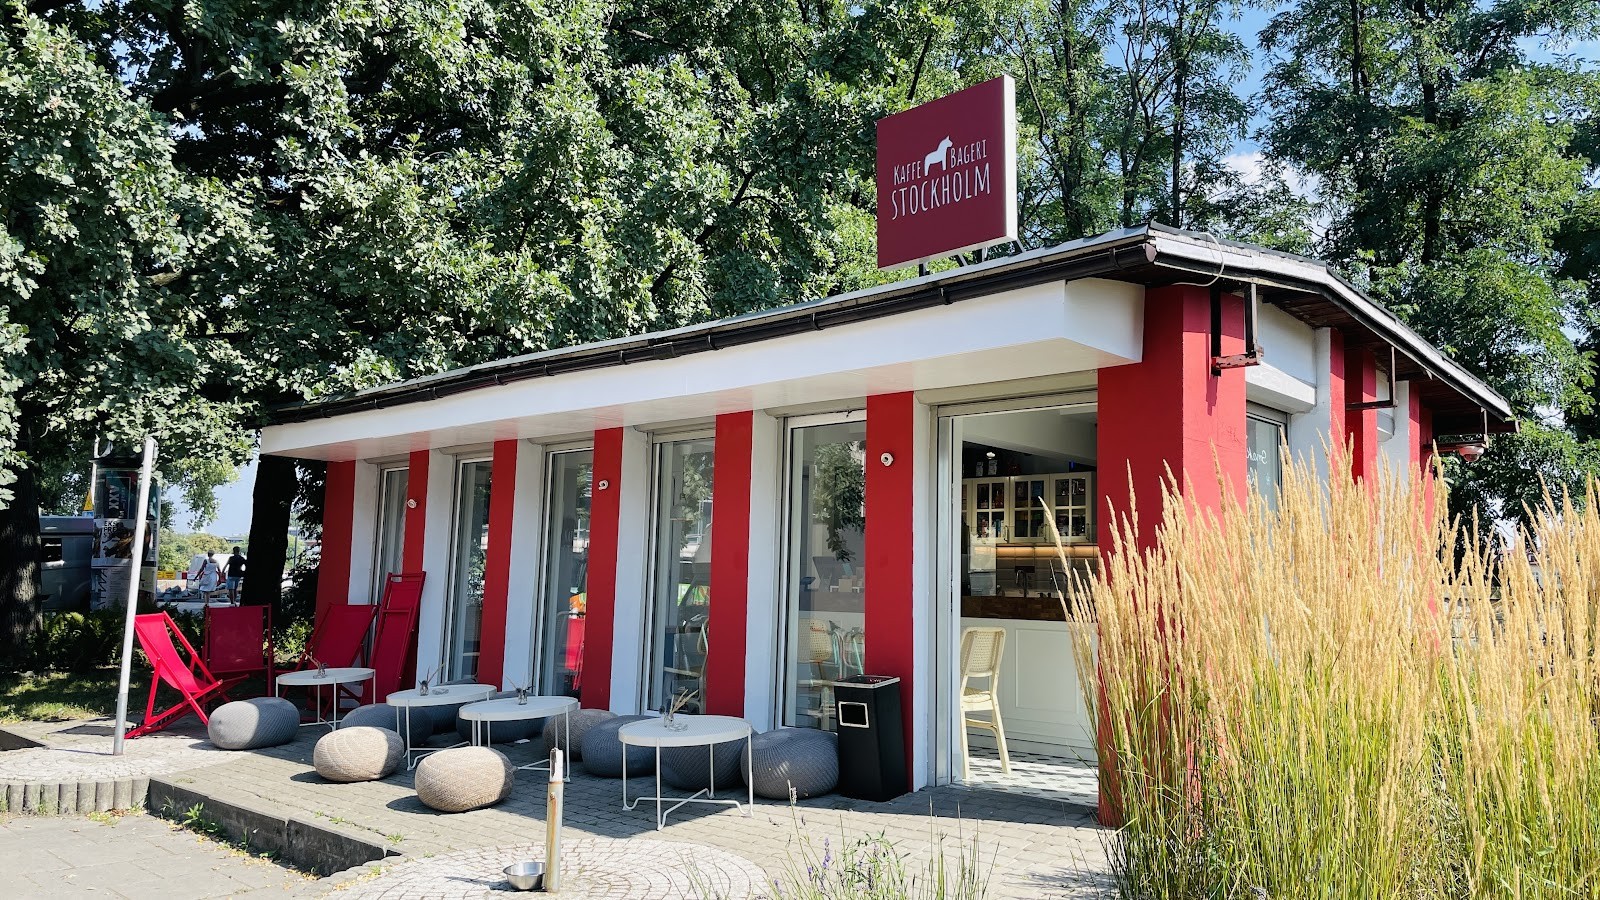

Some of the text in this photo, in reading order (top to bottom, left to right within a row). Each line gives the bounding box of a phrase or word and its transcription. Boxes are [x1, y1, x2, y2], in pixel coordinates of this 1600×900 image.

[894, 139, 987, 186] KAFFE BAGERI
[891, 162, 991, 220] STOCKHOLM
